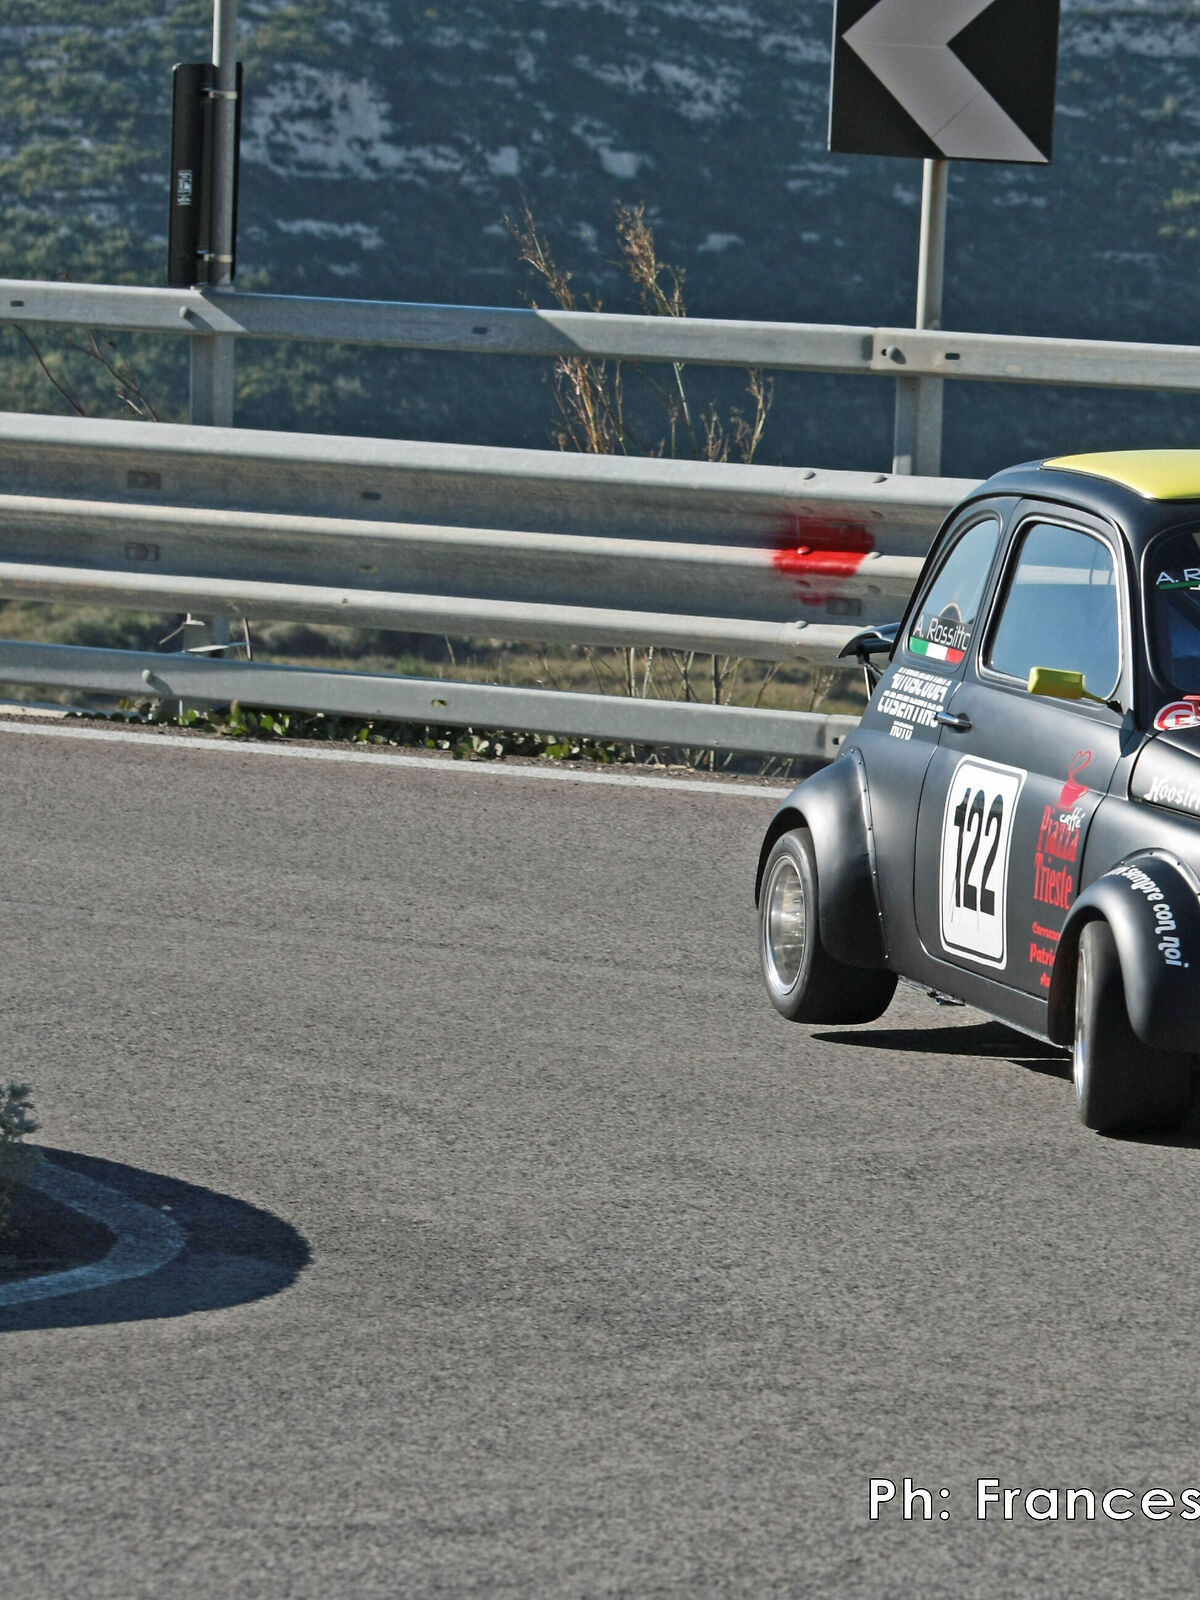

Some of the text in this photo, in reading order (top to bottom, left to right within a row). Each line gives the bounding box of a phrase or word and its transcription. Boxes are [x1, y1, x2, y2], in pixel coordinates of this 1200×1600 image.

[926, 617, 971, 651] Rossitto
[954, 787, 1003, 917] 122
[1033, 852, 1074, 911] Trieste
[1153, 903, 1177, 935] con
[1158, 935, 1190, 968] noi
